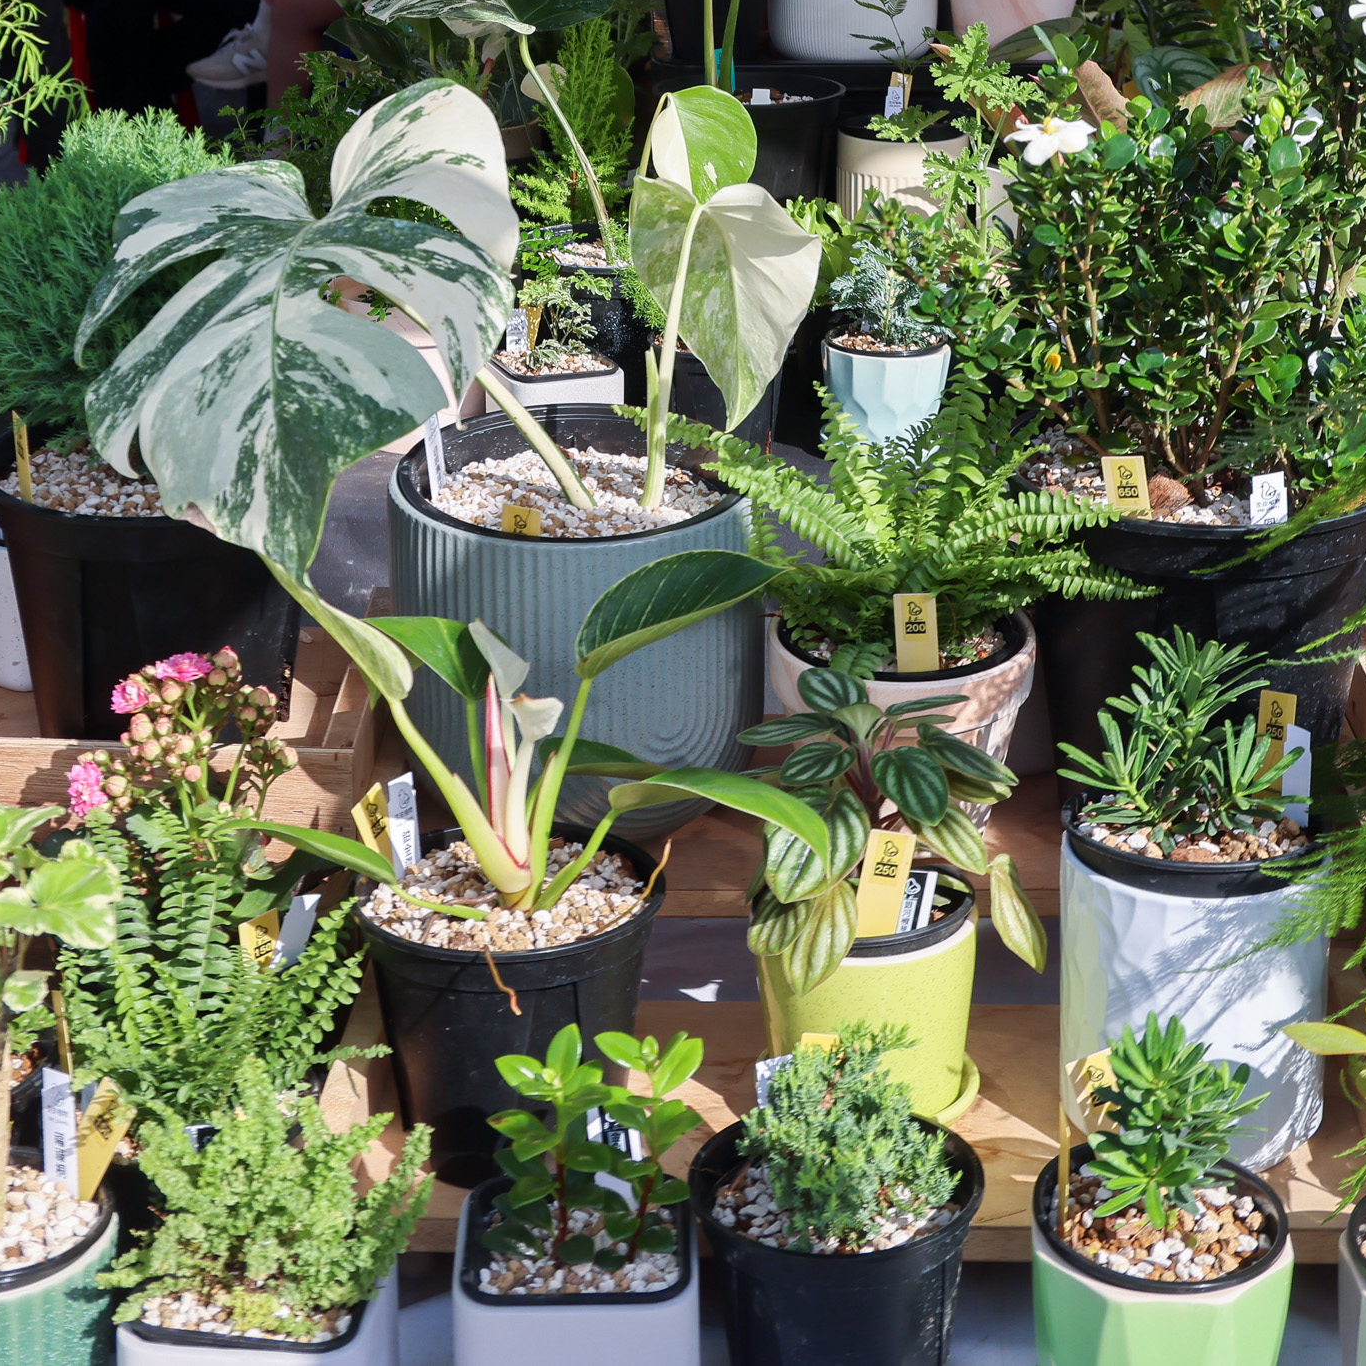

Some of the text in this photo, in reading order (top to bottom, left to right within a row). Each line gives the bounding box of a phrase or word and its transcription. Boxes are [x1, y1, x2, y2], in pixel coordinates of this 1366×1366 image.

[1118, 486, 1138, 498] 650
[905, 623, 926, 634] 200
[1266, 726, 1284, 739] 250
[875, 864, 897, 876] 250
